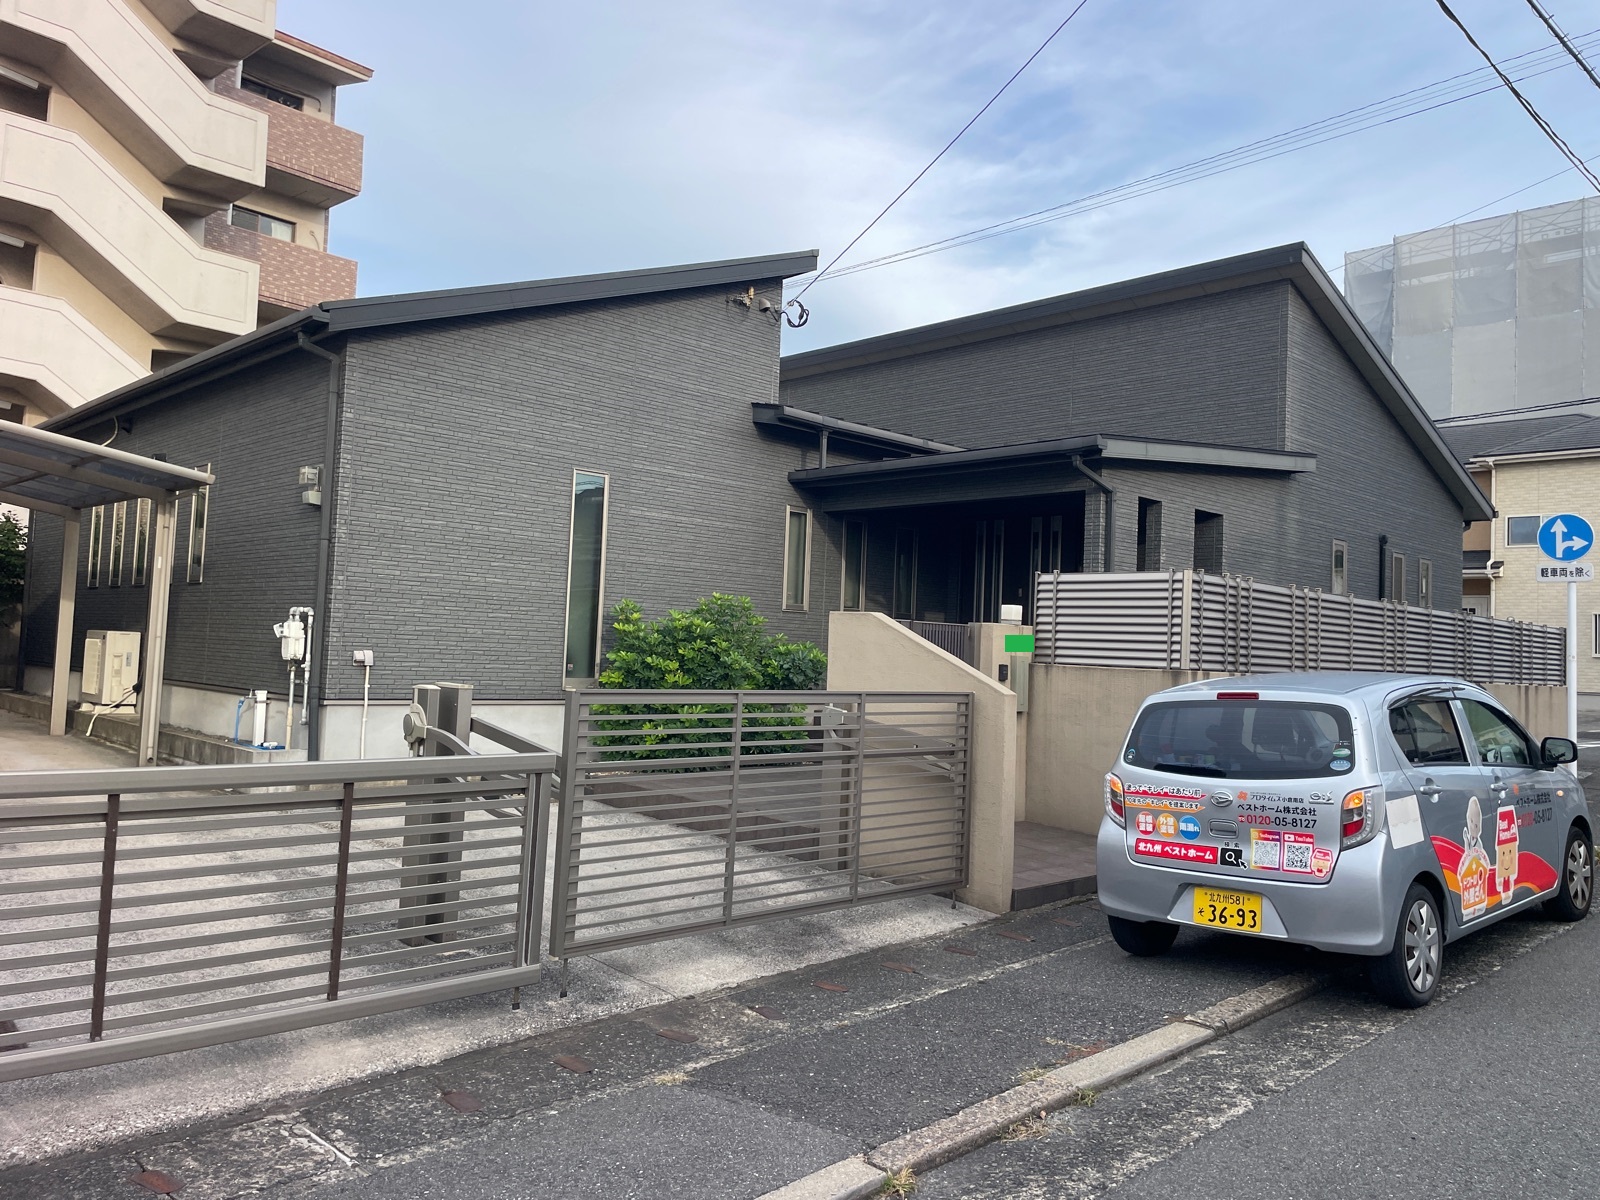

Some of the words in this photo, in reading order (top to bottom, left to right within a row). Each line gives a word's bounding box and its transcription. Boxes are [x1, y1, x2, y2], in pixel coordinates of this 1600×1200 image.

[1540, 567, 1591, 578] 軽車両を除く
[1238, 804, 1317, 817] ベストホーム株式会社
[1246, 814, 1317, 829] 0120-05-8127
[1138, 842, 1162, 853] 北九州
[1164, 845, 1213, 860] ベストホーム
[1208, 904, 1257, 929] 36-93
